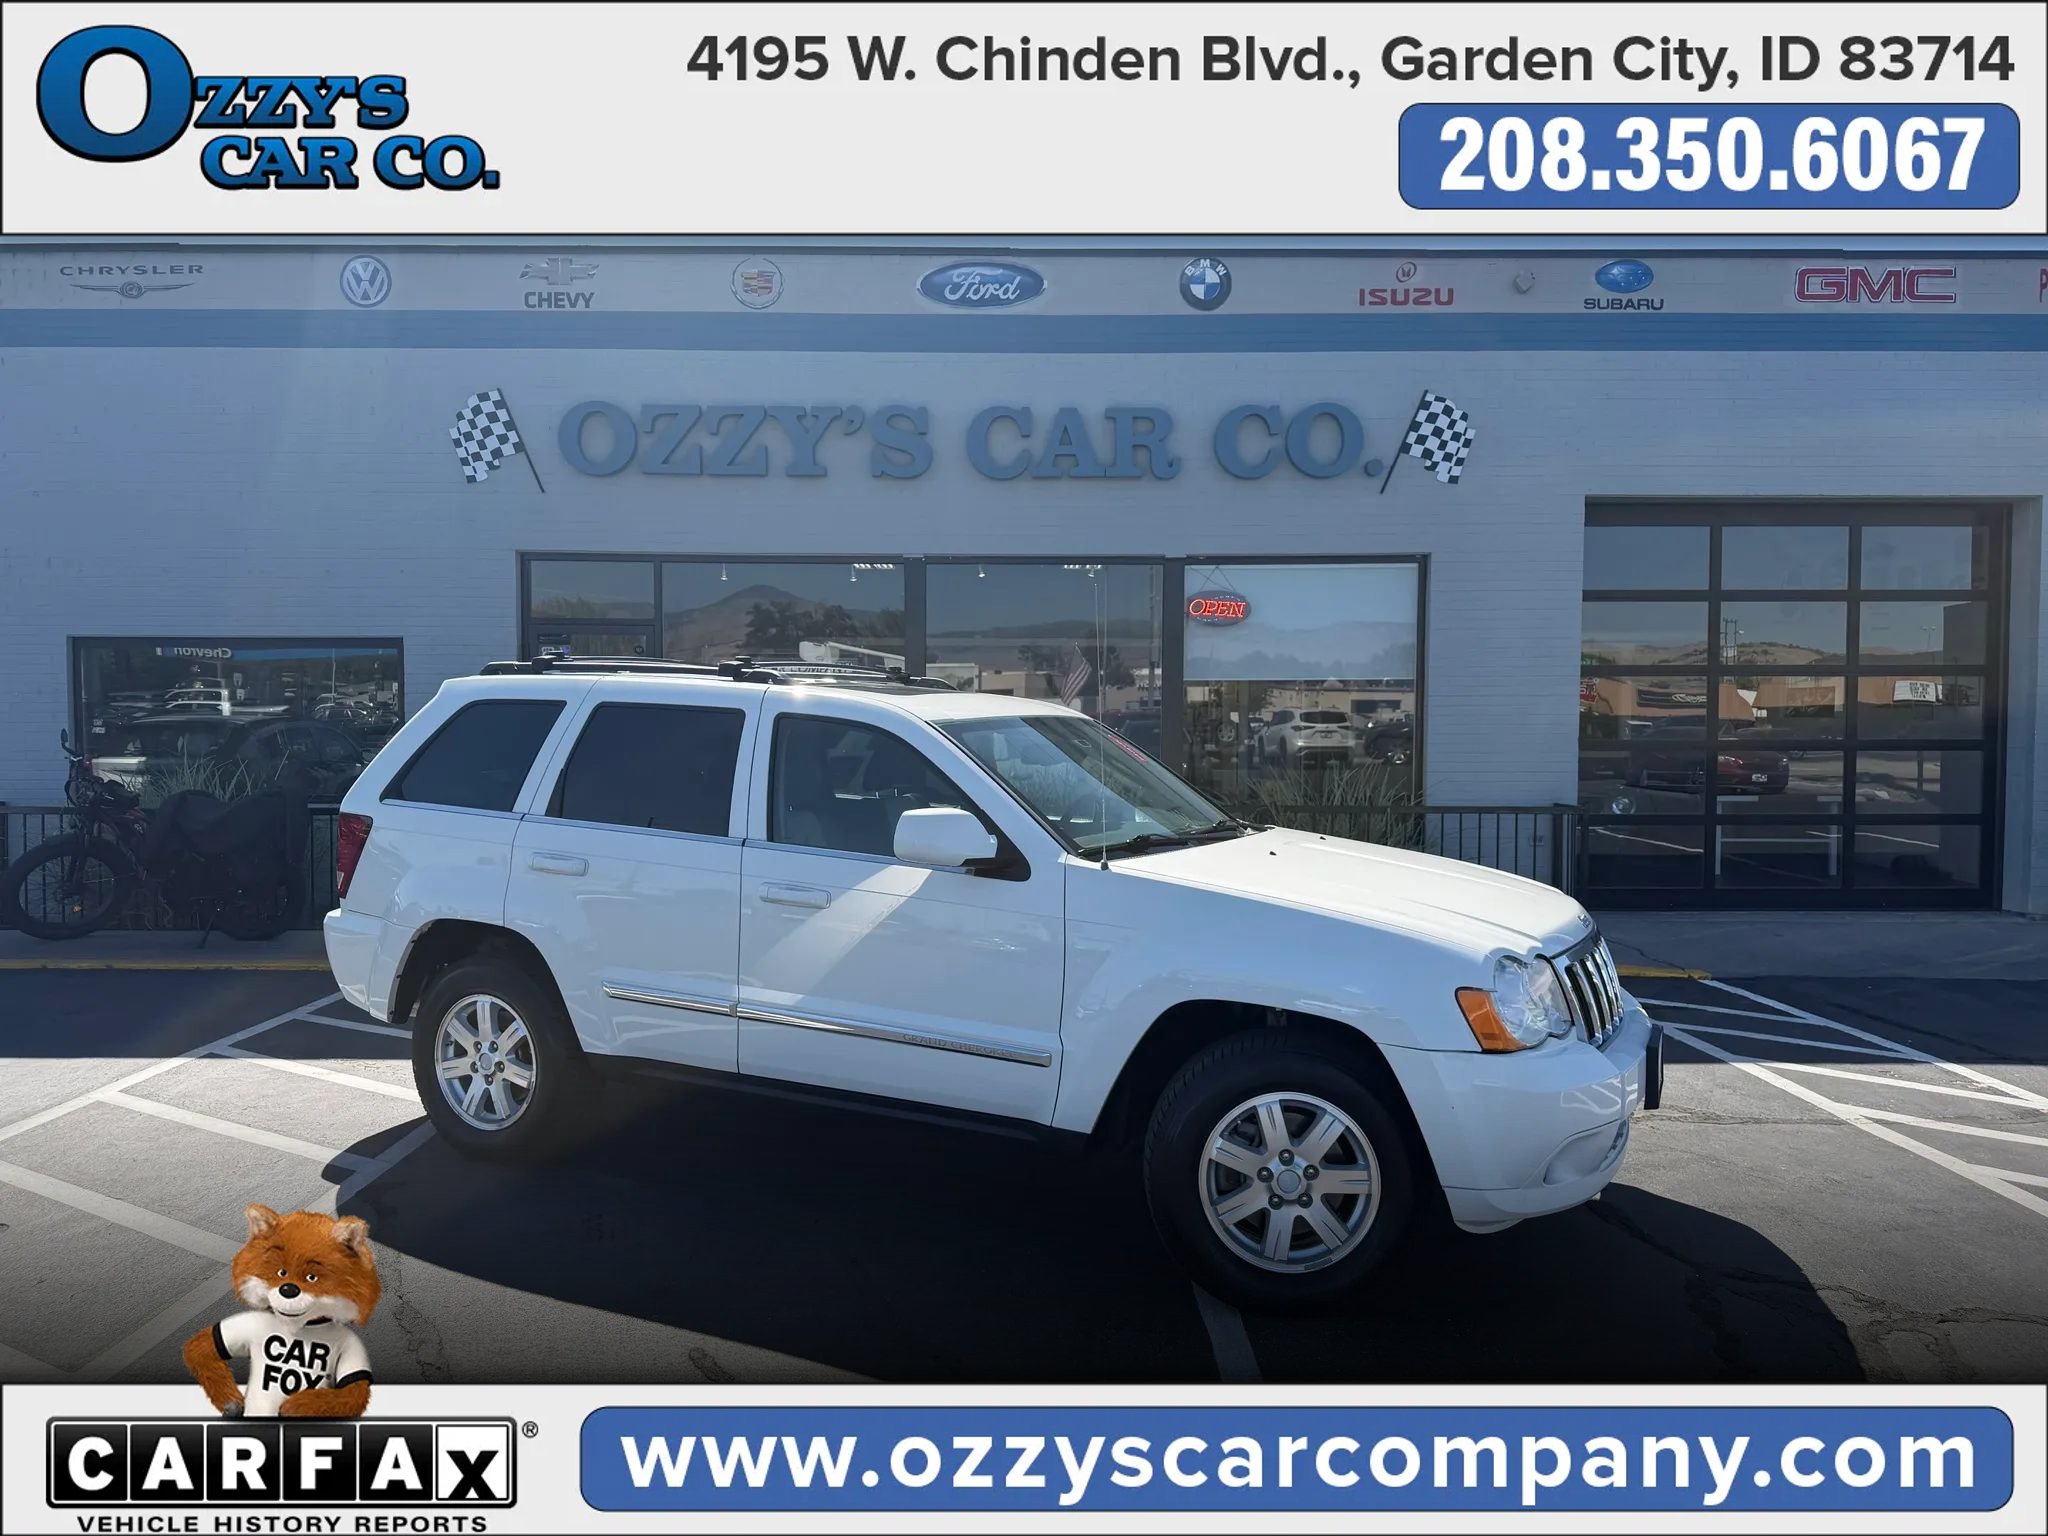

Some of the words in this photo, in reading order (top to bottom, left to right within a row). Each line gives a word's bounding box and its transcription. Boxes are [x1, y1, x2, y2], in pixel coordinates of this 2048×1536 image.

[59, 264, 204, 276] CHRYSLER
[1184, 258, 1227, 277] BMW
[944, 268, 1021, 300] Ford
[1795, 266, 1957, 303] GMC
[524, 291, 595, 309] CHEVY
[1358, 287, 1454, 307] ISUZU
[1584, 298, 1664, 311] SUBARU
[557, 400, 933, 480] OZZY'S
[966, 405, 1181, 481] CAR
[1214, 402, 1384, 480] CO.
[1189, 599, 1246, 618] OPEN
[903, 1033, 946, 1047] GRAND
